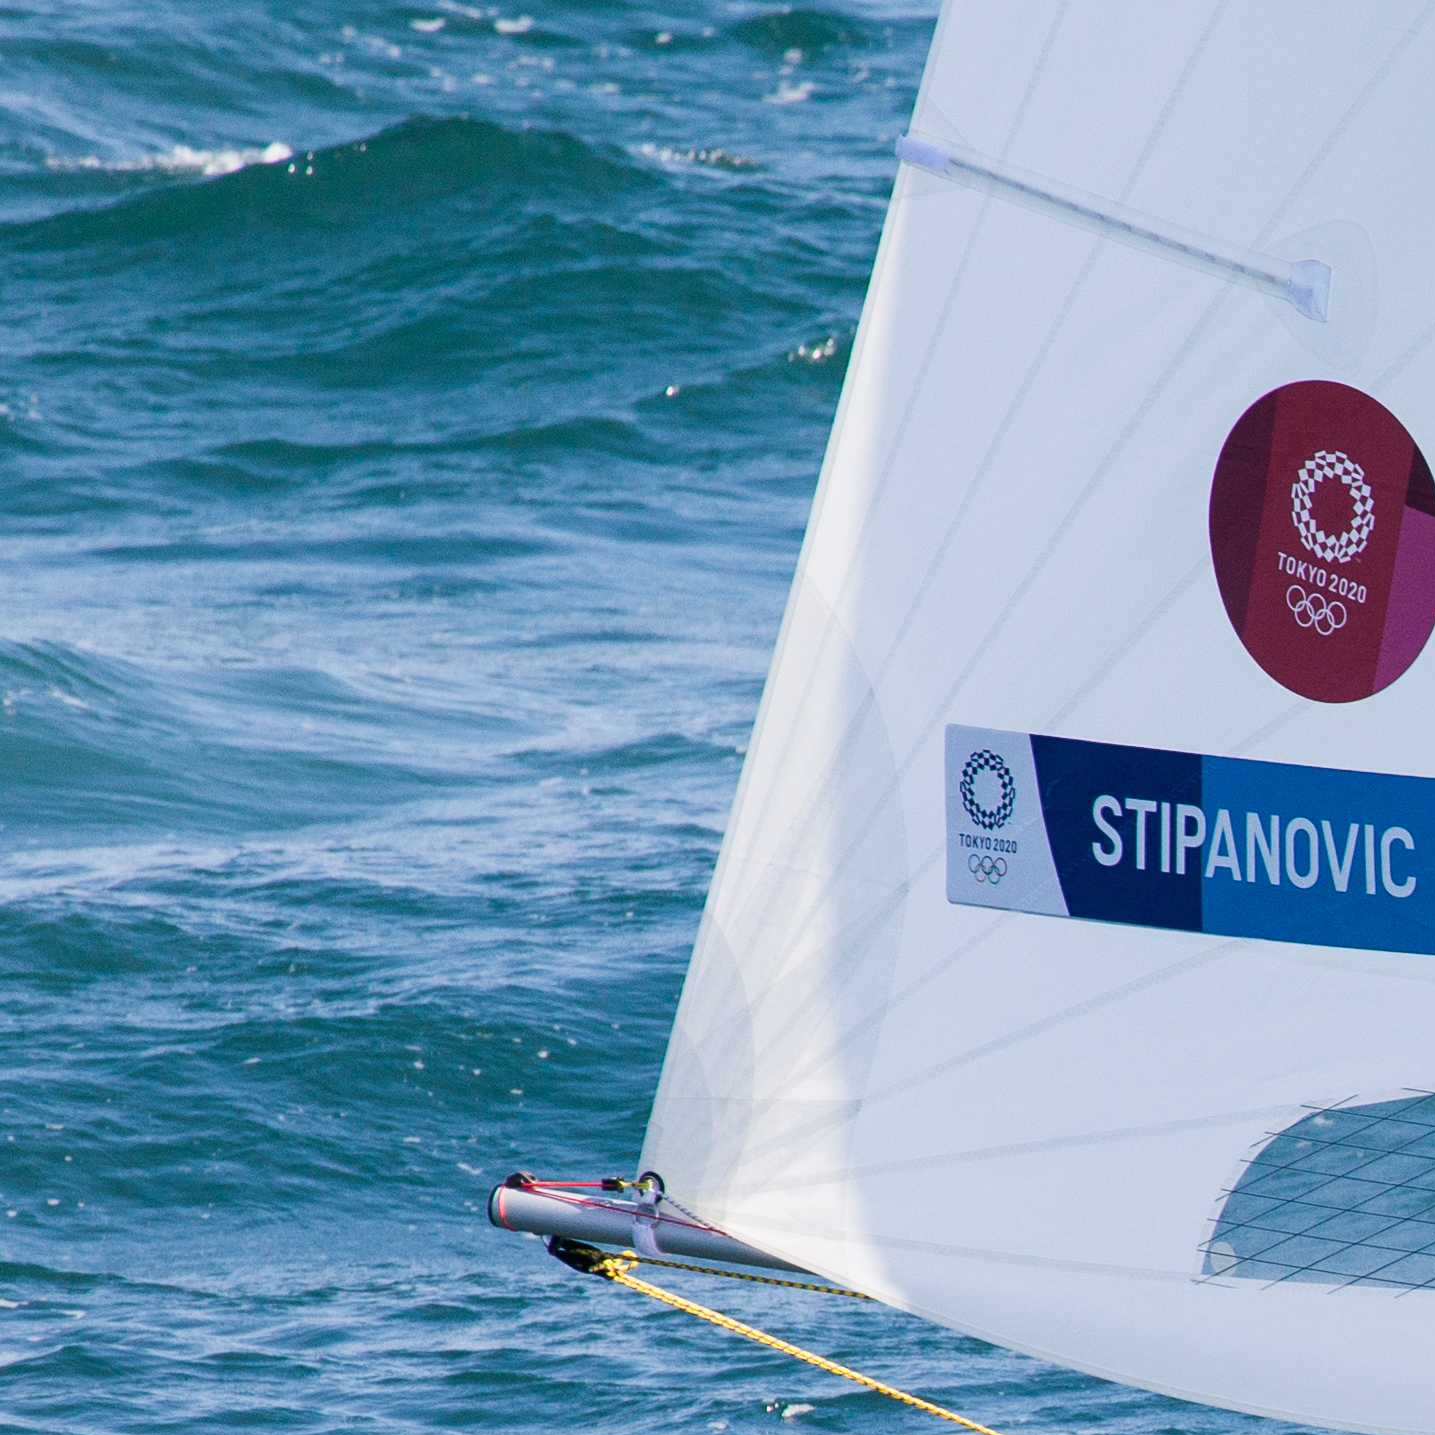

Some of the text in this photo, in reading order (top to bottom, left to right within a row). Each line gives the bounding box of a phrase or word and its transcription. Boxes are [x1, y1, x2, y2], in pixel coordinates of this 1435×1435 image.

[1277, 551, 1367, 604] TOKYO 2020
[958, 833, 1017, 854] TOKYO 2020
[1091, 794, 1417, 898] STIPANOVIC
